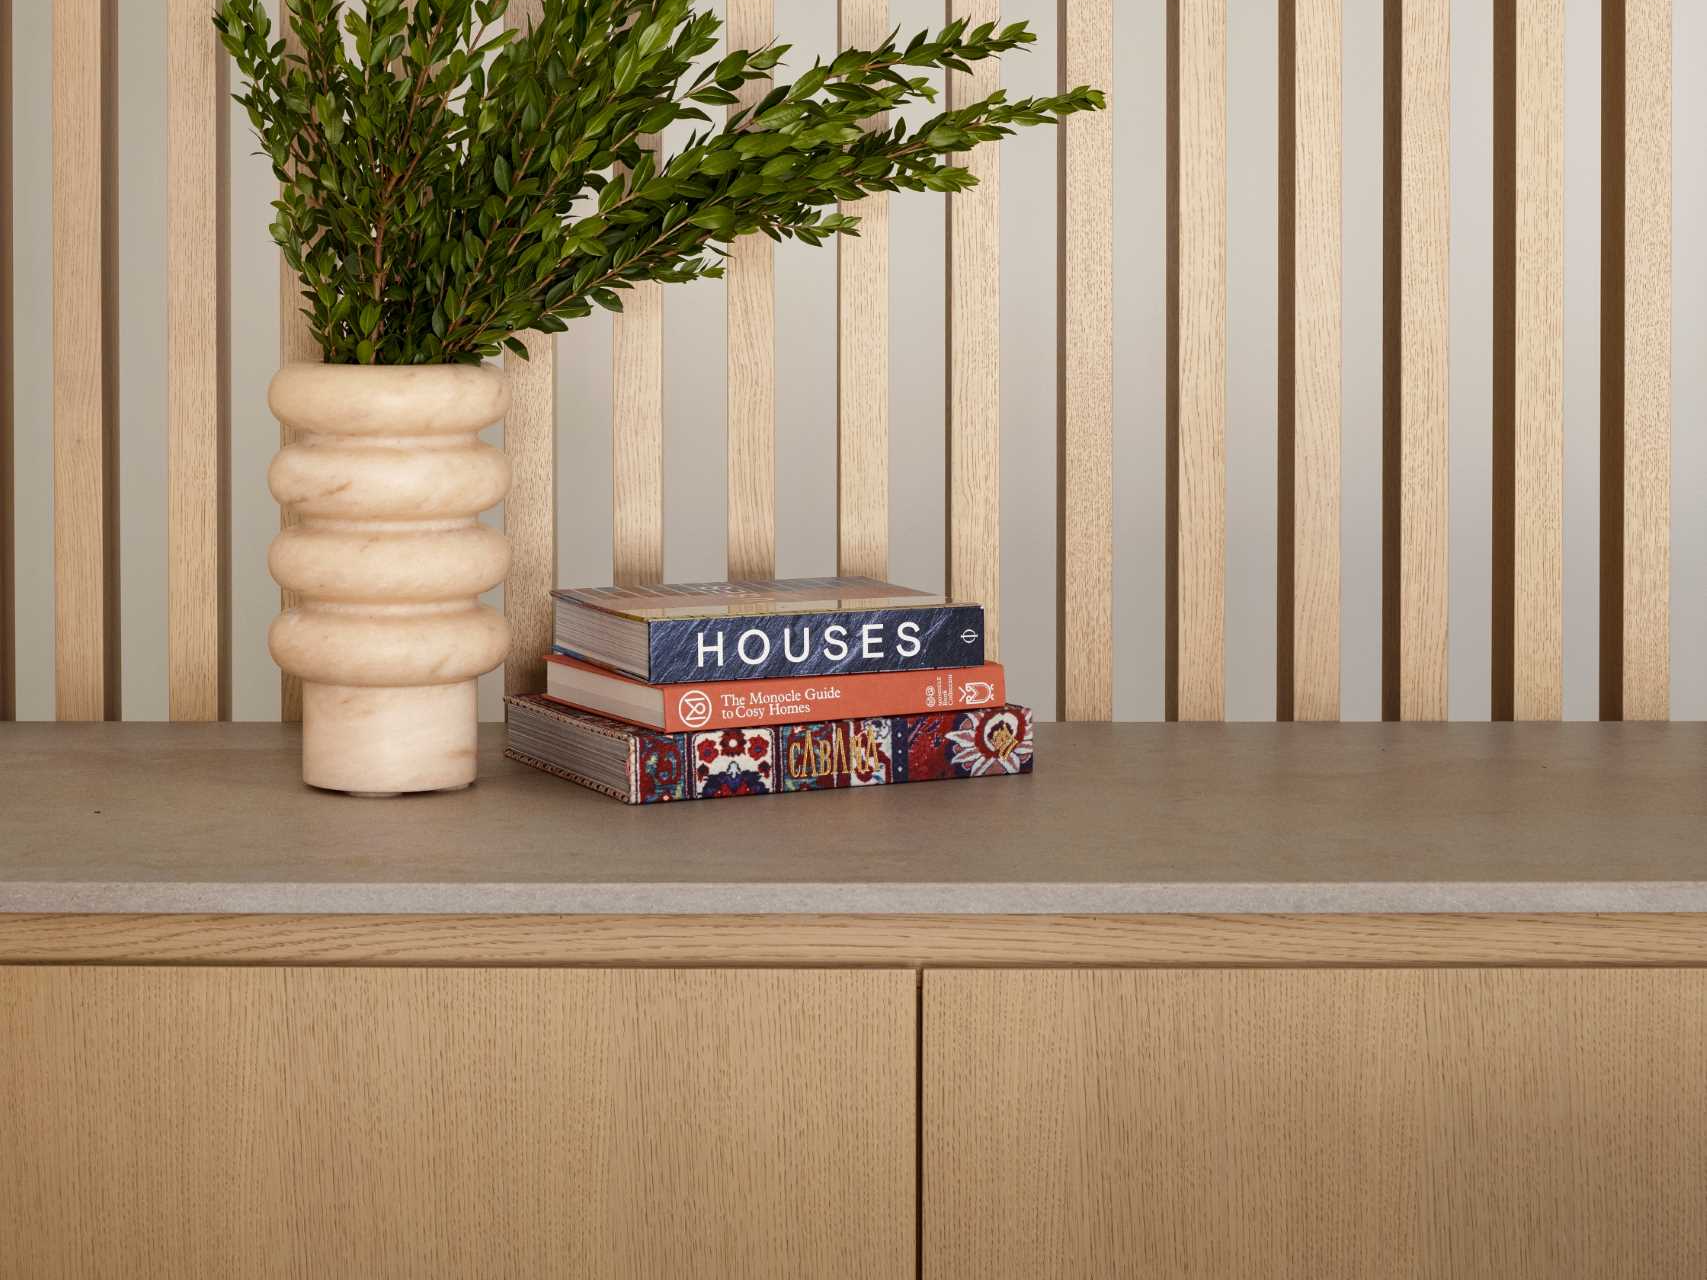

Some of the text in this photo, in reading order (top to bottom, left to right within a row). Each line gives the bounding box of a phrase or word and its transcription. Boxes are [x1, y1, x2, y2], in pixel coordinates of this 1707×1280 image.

[697, 622, 921, 667] HOUSES
[721, 687, 841, 706] The Monocle Guide
[722, 702, 810, 719] to Cosy Homes
[789, 725, 880, 777] CABANA
